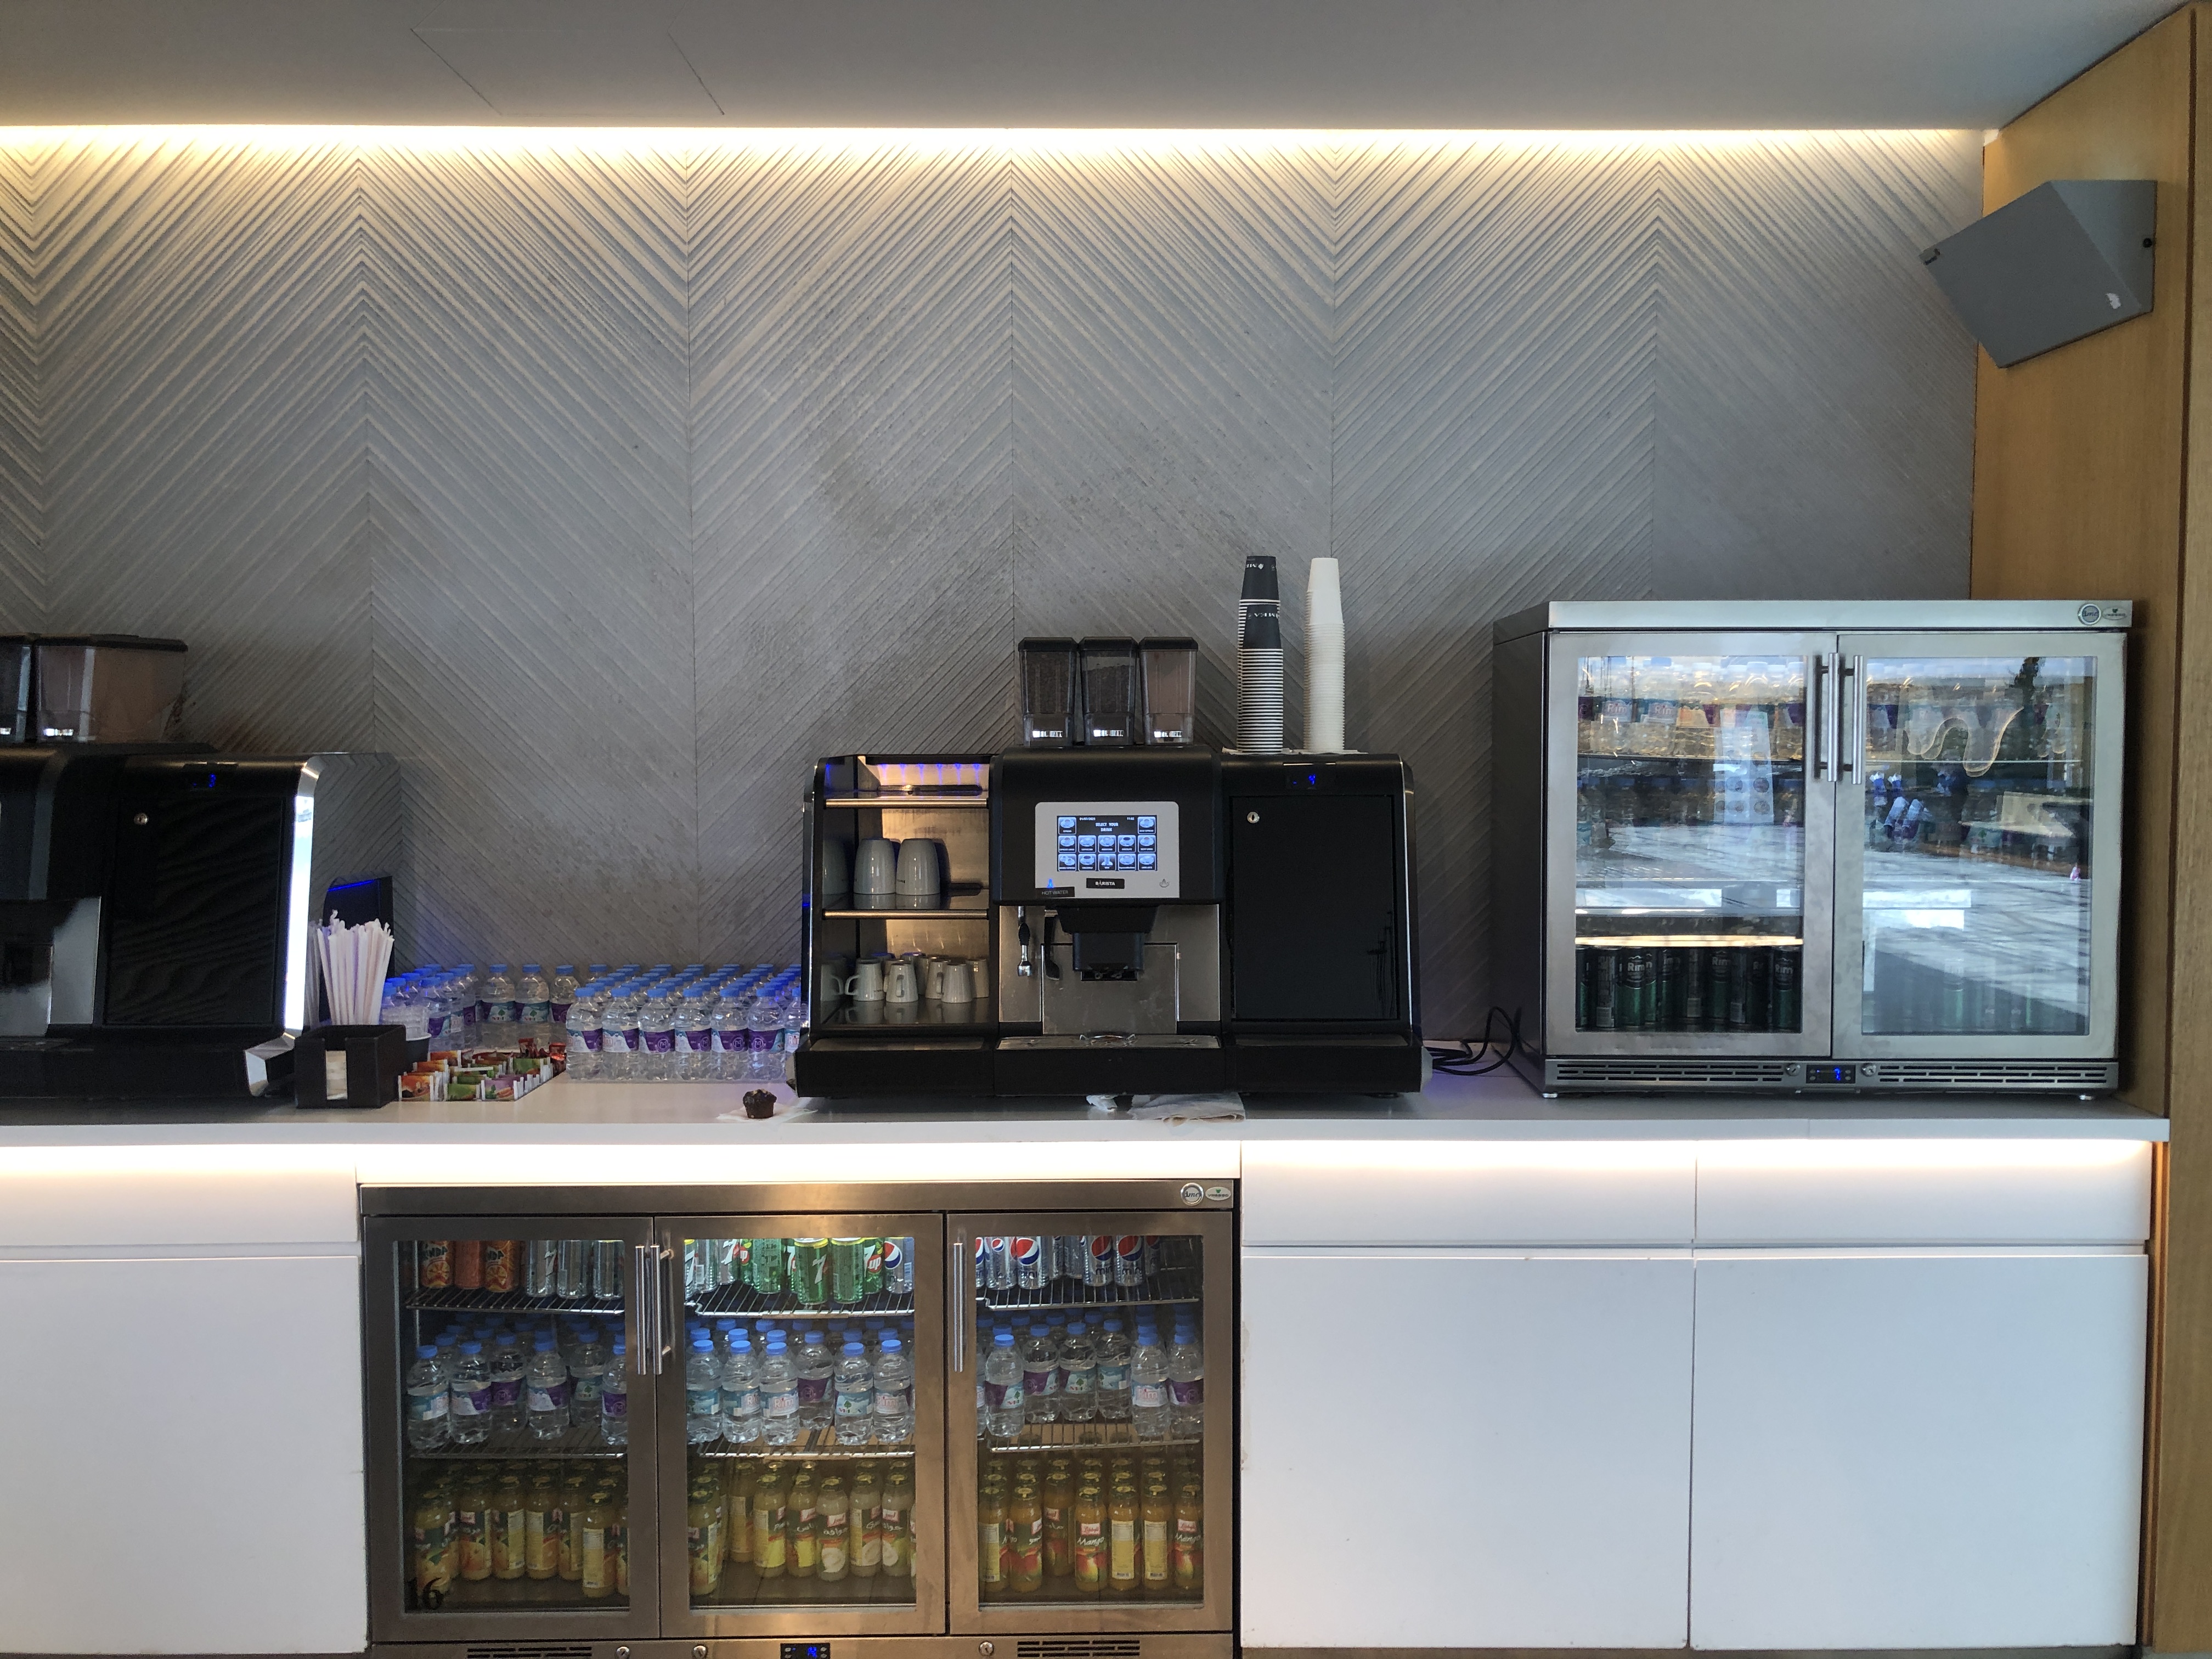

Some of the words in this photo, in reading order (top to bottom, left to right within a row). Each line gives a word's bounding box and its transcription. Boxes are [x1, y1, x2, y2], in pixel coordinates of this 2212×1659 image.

[1607, 703, 1628, 714] Rim
[774, 1397, 794, 1408] Rim
[1077, 1537, 1105, 1547] Mango
